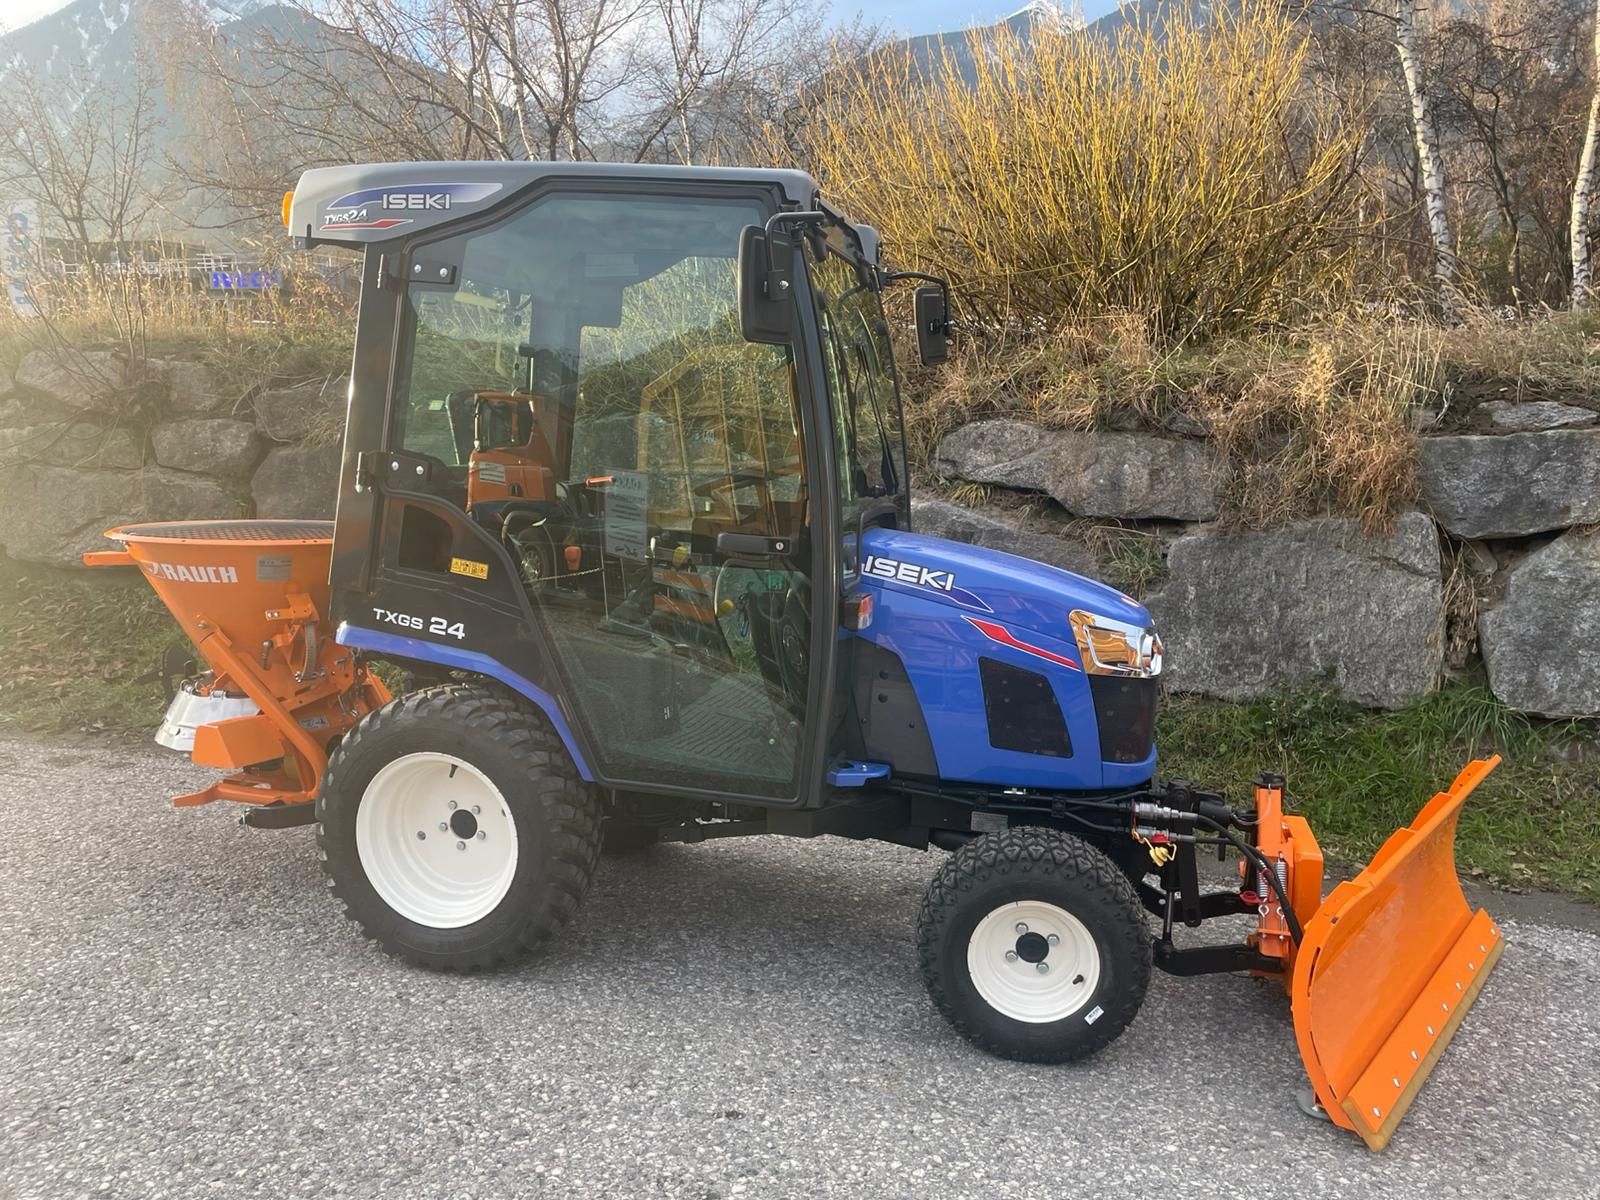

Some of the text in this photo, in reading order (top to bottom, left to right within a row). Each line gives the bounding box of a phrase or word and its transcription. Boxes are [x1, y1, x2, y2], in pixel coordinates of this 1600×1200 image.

[382, 193, 451, 210] ISEKI
[160, 563, 239, 583] RAUCH
[863, 555, 956, 592] ISEKI
[373, 607, 466, 640] TXGS 24
